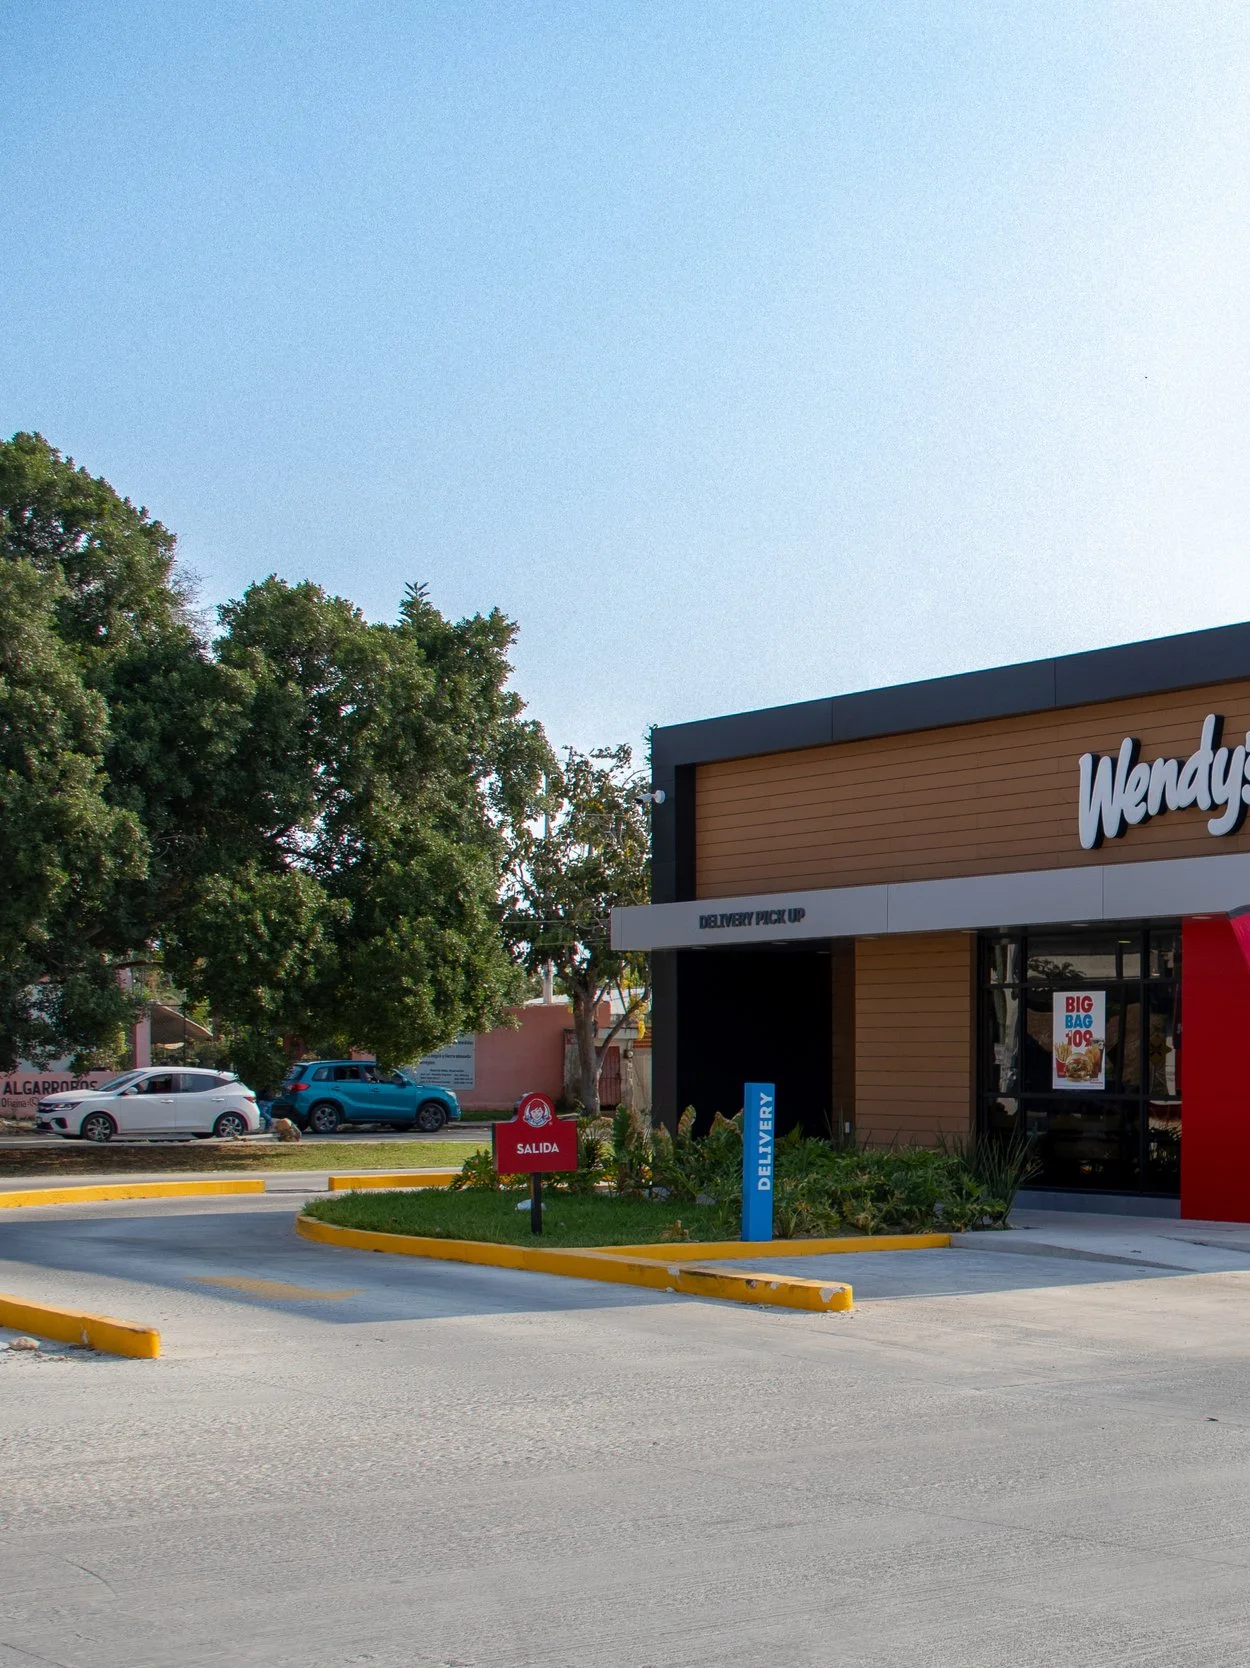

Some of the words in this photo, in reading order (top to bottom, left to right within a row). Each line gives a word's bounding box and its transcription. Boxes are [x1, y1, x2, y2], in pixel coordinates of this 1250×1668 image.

[699, 911, 754, 929] DELIVERY
[755, 909, 787, 926] PICK
[788, 907, 806, 924] UP
[1065, 995, 1094, 1013] BIG
[1065, 1014, 1094, 1029] BAG
[516, 1142, 560, 1155] SALIDA
[758, 1091, 773, 1191] DELIVERY
